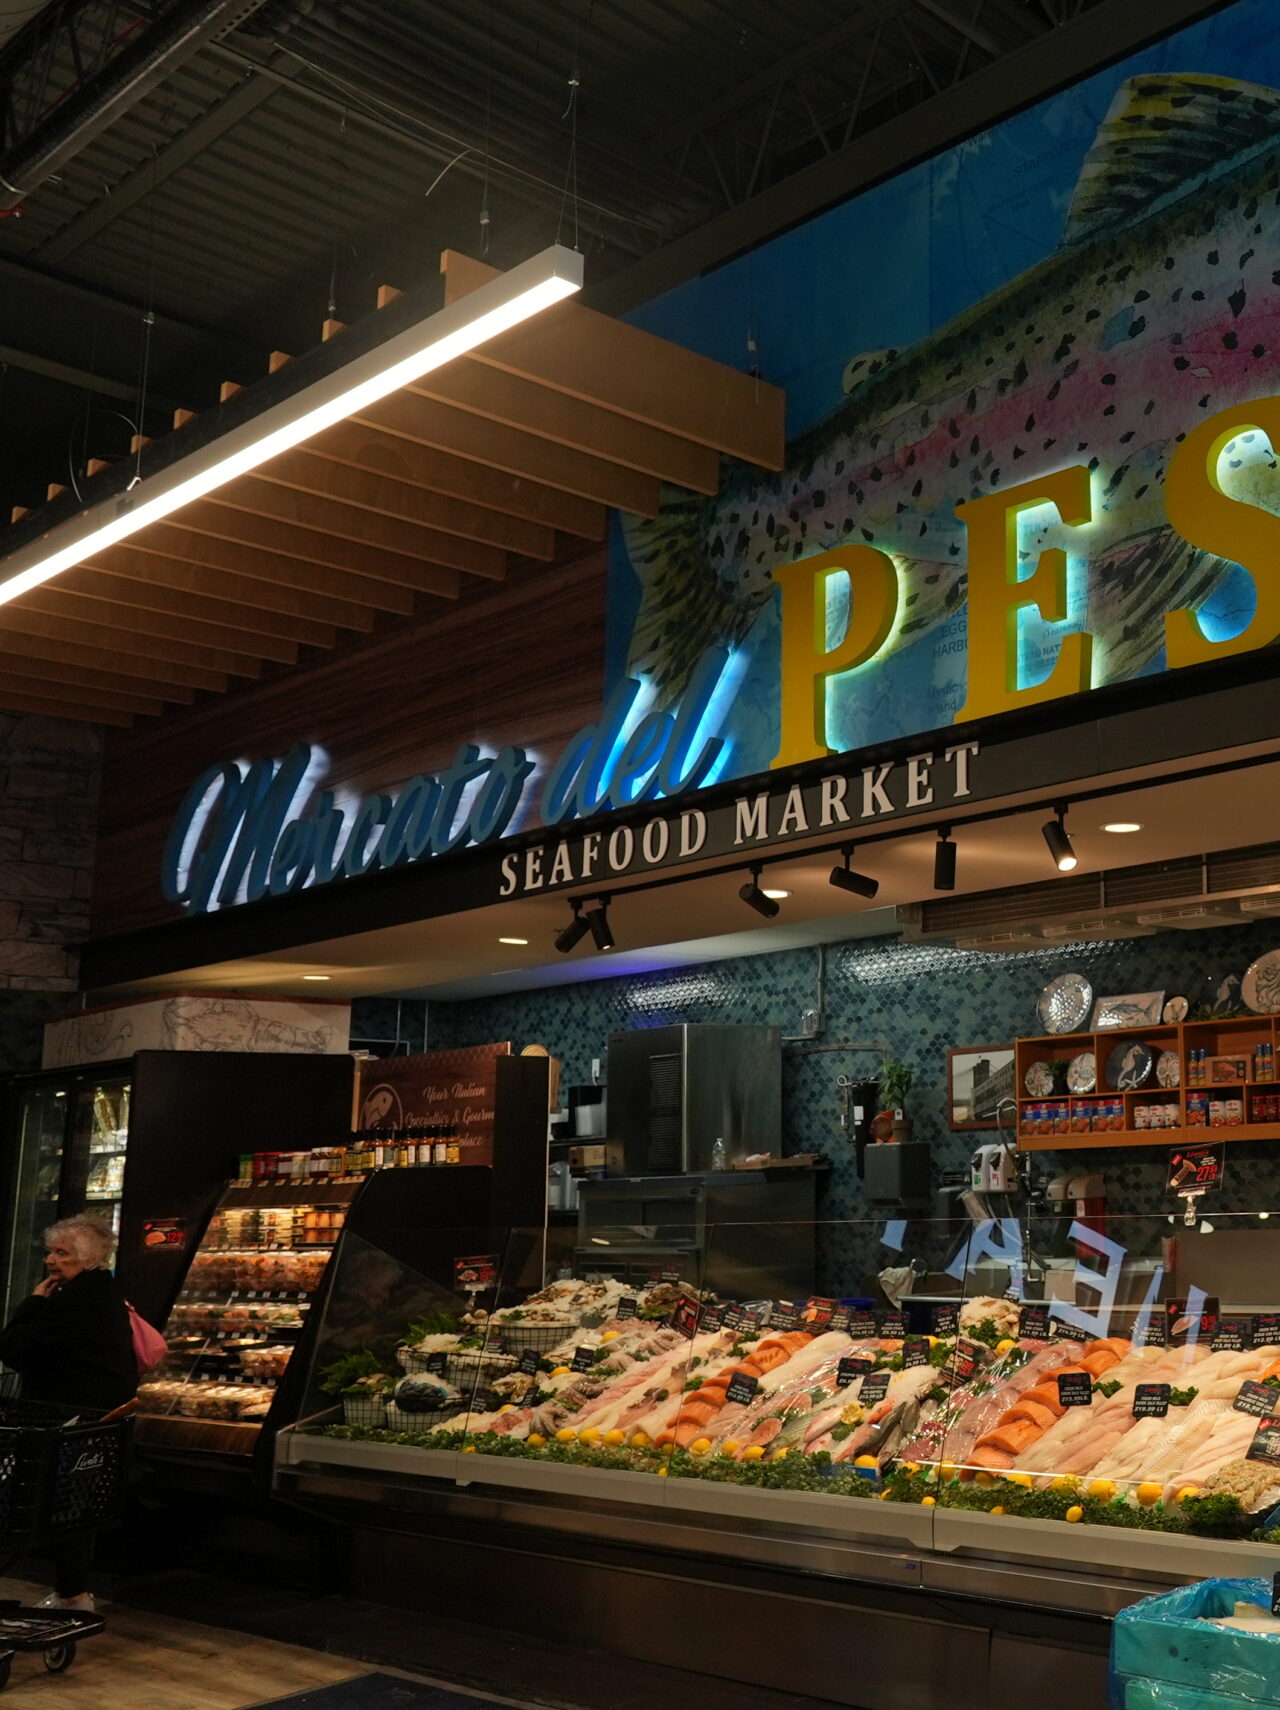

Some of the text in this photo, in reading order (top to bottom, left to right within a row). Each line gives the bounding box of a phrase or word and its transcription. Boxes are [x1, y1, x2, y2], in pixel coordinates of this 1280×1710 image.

[161, 644, 735, 918] Mercato del
[498, 740, 981, 898] SEAFOOD MARKET
[422, 1082, 487, 1104] Your Italian
[463, 1106, 496, 1126] Gourm
